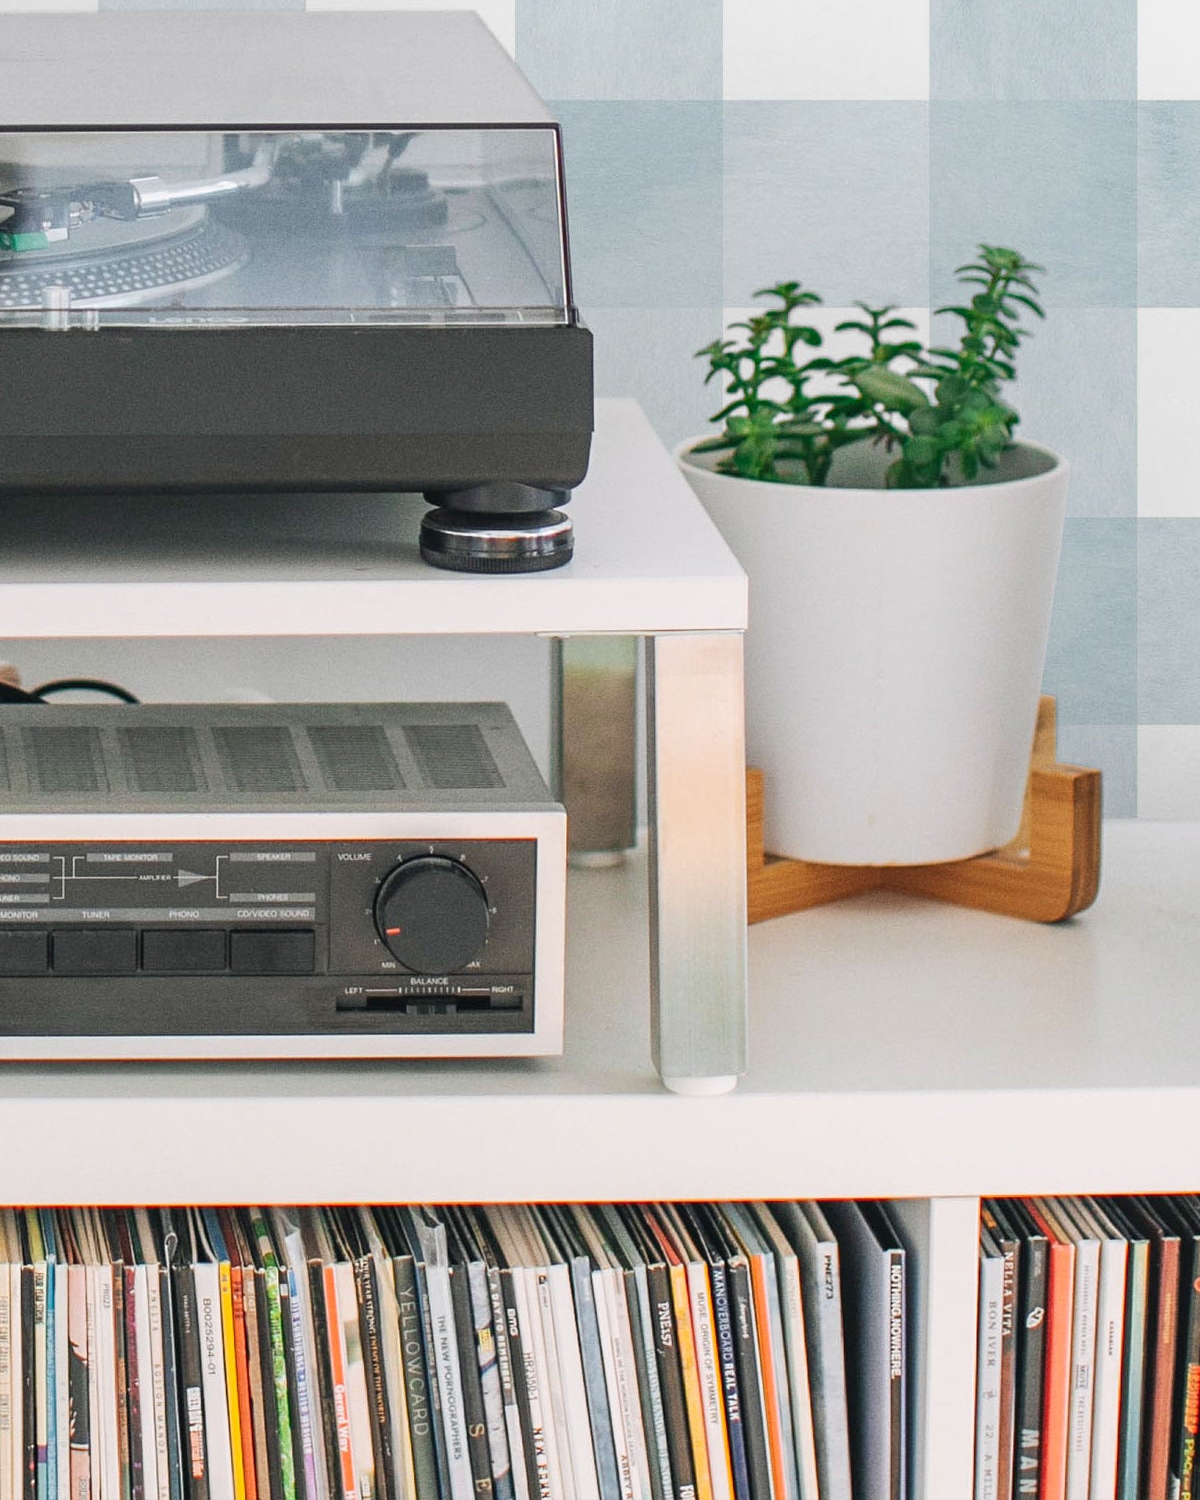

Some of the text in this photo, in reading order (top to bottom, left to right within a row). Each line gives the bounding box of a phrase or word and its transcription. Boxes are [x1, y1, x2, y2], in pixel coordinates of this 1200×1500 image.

[13, 854, 40, 862] SOUND
[103, 854, 158, 862] TAPE MONITOR
[257, 853, 291, 861] SPEAKER
[337, 853, 372, 861] VOLUME
[0, 911, 39, 919] MONITOR
[82, 911, 111, 919] TUNER
[169, 910, 200, 919] PHONO
[237, 910, 310, 919] CD/VIDEO SOUND
[345, 986, 364, 994] LEFT
[410, 977, 449, 985] BALANCE
[364, 1281, 372, 1300] YEAR
[823, 1255, 834, 1300] PNE273
[492, 1293, 501, 1316] DAY
[1002, 1251, 1014, 1336] NELLA VITA
[365, 1300, 376, 1334] STRONG
[495, 1317, 504, 1331] TO
[507, 1308, 519, 1337] BMG
[658, 1301, 673, 1347] PNE157
[988, 1300, 998, 1333] BON
[699, 1323, 711, 1357] ORIGIN
[987, 1336, 997, 1367] IVER
[400, 1287, 429, 1436] YELLOWCARD
[497, 1335, 512, 1390] REMEMBER
[704, 1358, 713, 1371] OF
[437, 1315, 461, 1461] THE NEW PORNOGRAPHERS
[724, 1362, 738, 1390] REAL
[154, 1363, 166, 1455] BOSTON MANOR
[375, 1392, 386, 1424] WORLD
[705, 1373, 719, 1425] SYMMETRY
[726, 1392, 739, 1422] TALK
[334, 1384, 350, 1453] Gerard Way
[534, 1427, 546, 1455] NEW
[620, 1455, 632, 1489] ABBEY
[984, 1454, 994, 1462] A
